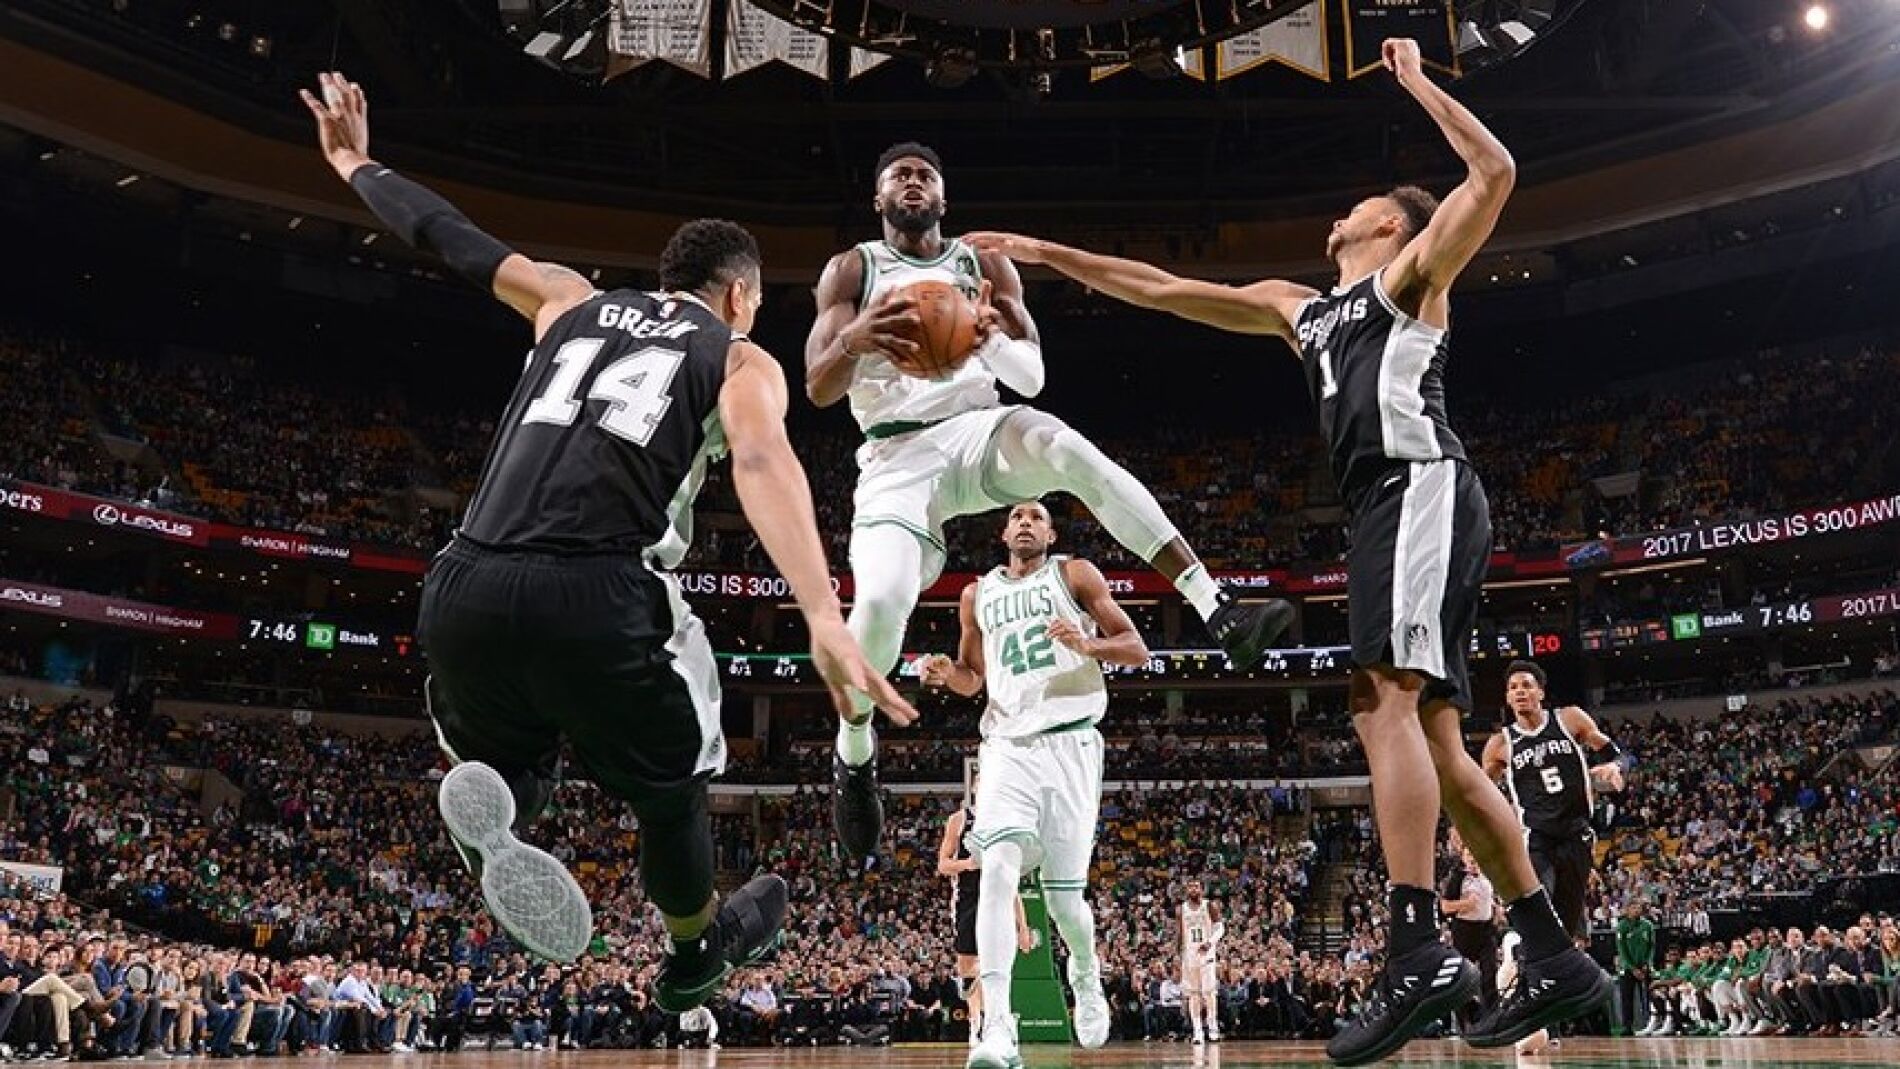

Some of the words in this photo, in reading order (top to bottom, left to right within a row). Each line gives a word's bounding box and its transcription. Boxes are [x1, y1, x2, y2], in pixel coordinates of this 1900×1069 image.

[1318, 349, 1339, 399] 1
[521, 337, 688, 448] 14
[121, 512, 193, 537] LEXUS
[1643, 532, 1692, 558] 2017
[1699, 519, 1779, 550] LEXUS
[1784, 514, 1808, 537] IS
[1813, 506, 1857, 532] 300
[0, 587, 63, 608] EXUS
[721, 575, 743, 595] IS
[748, 577, 787, 597] 300
[983, 583, 1052, 634] CELTICS
[1760, 602, 1812, 627] 7:46
[1841, 595, 1887, 617] 2017
[250, 619, 297, 642] 7:46
[1703, 610, 1743, 628] Bank
[339, 630, 379, 646] Bank
[1001, 622, 1057, 676] 42
[1534, 635, 1559, 652] 20
[1512, 739, 1573, 769] SPURS
[1540, 766, 1565, 794] 5
[1190, 928, 1203, 943] 11
